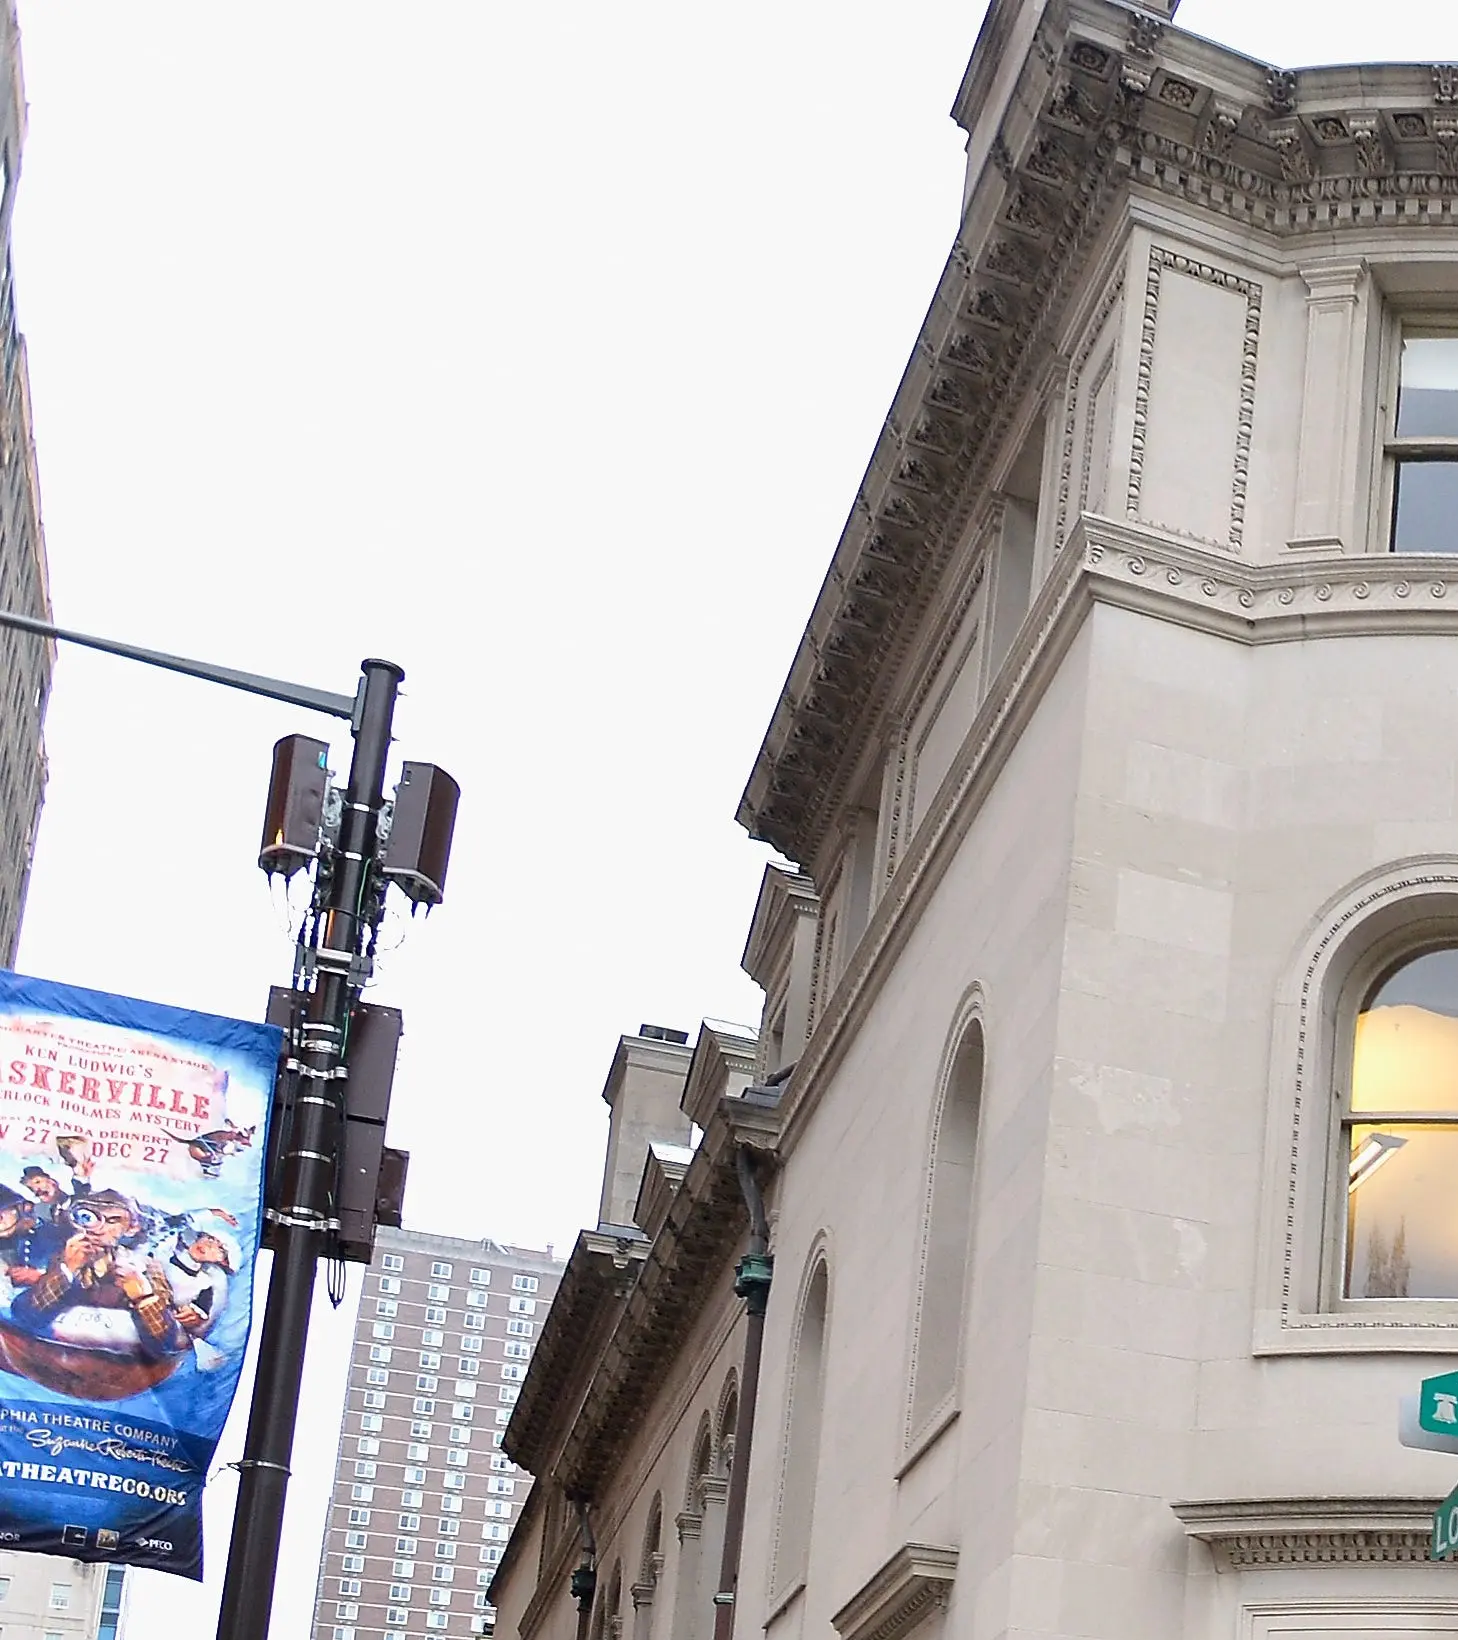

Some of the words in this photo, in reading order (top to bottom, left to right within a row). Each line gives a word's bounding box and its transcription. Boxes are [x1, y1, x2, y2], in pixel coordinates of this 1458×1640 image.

[25, 1044, 58, 1062] KEN
[69, 1055, 154, 1079] LUDWIG'S
[0, 1059, 211, 1121] SKERVILLE
[0, 1089, 51, 1107] RLOCK
[60, 1099, 122, 1120] HOLMES
[130, 1111, 202, 1133] MYSTERY
[23, 1126, 51, 1145] 27
[27, 1114, 94, 1138] AMANDA
[99, 1130, 173, 1147] DEHNERT
[91, 1141, 132, 1159] DEC
[143, 1145, 169, 1164] 27
[42, 1412, 111, 1433] THEATRE
[114, 1423, 179, 1449] COMPANY
[0, 1460, 188, 1507] THEATRECO.ORG
[149, 1538, 174, 1552] PECO
